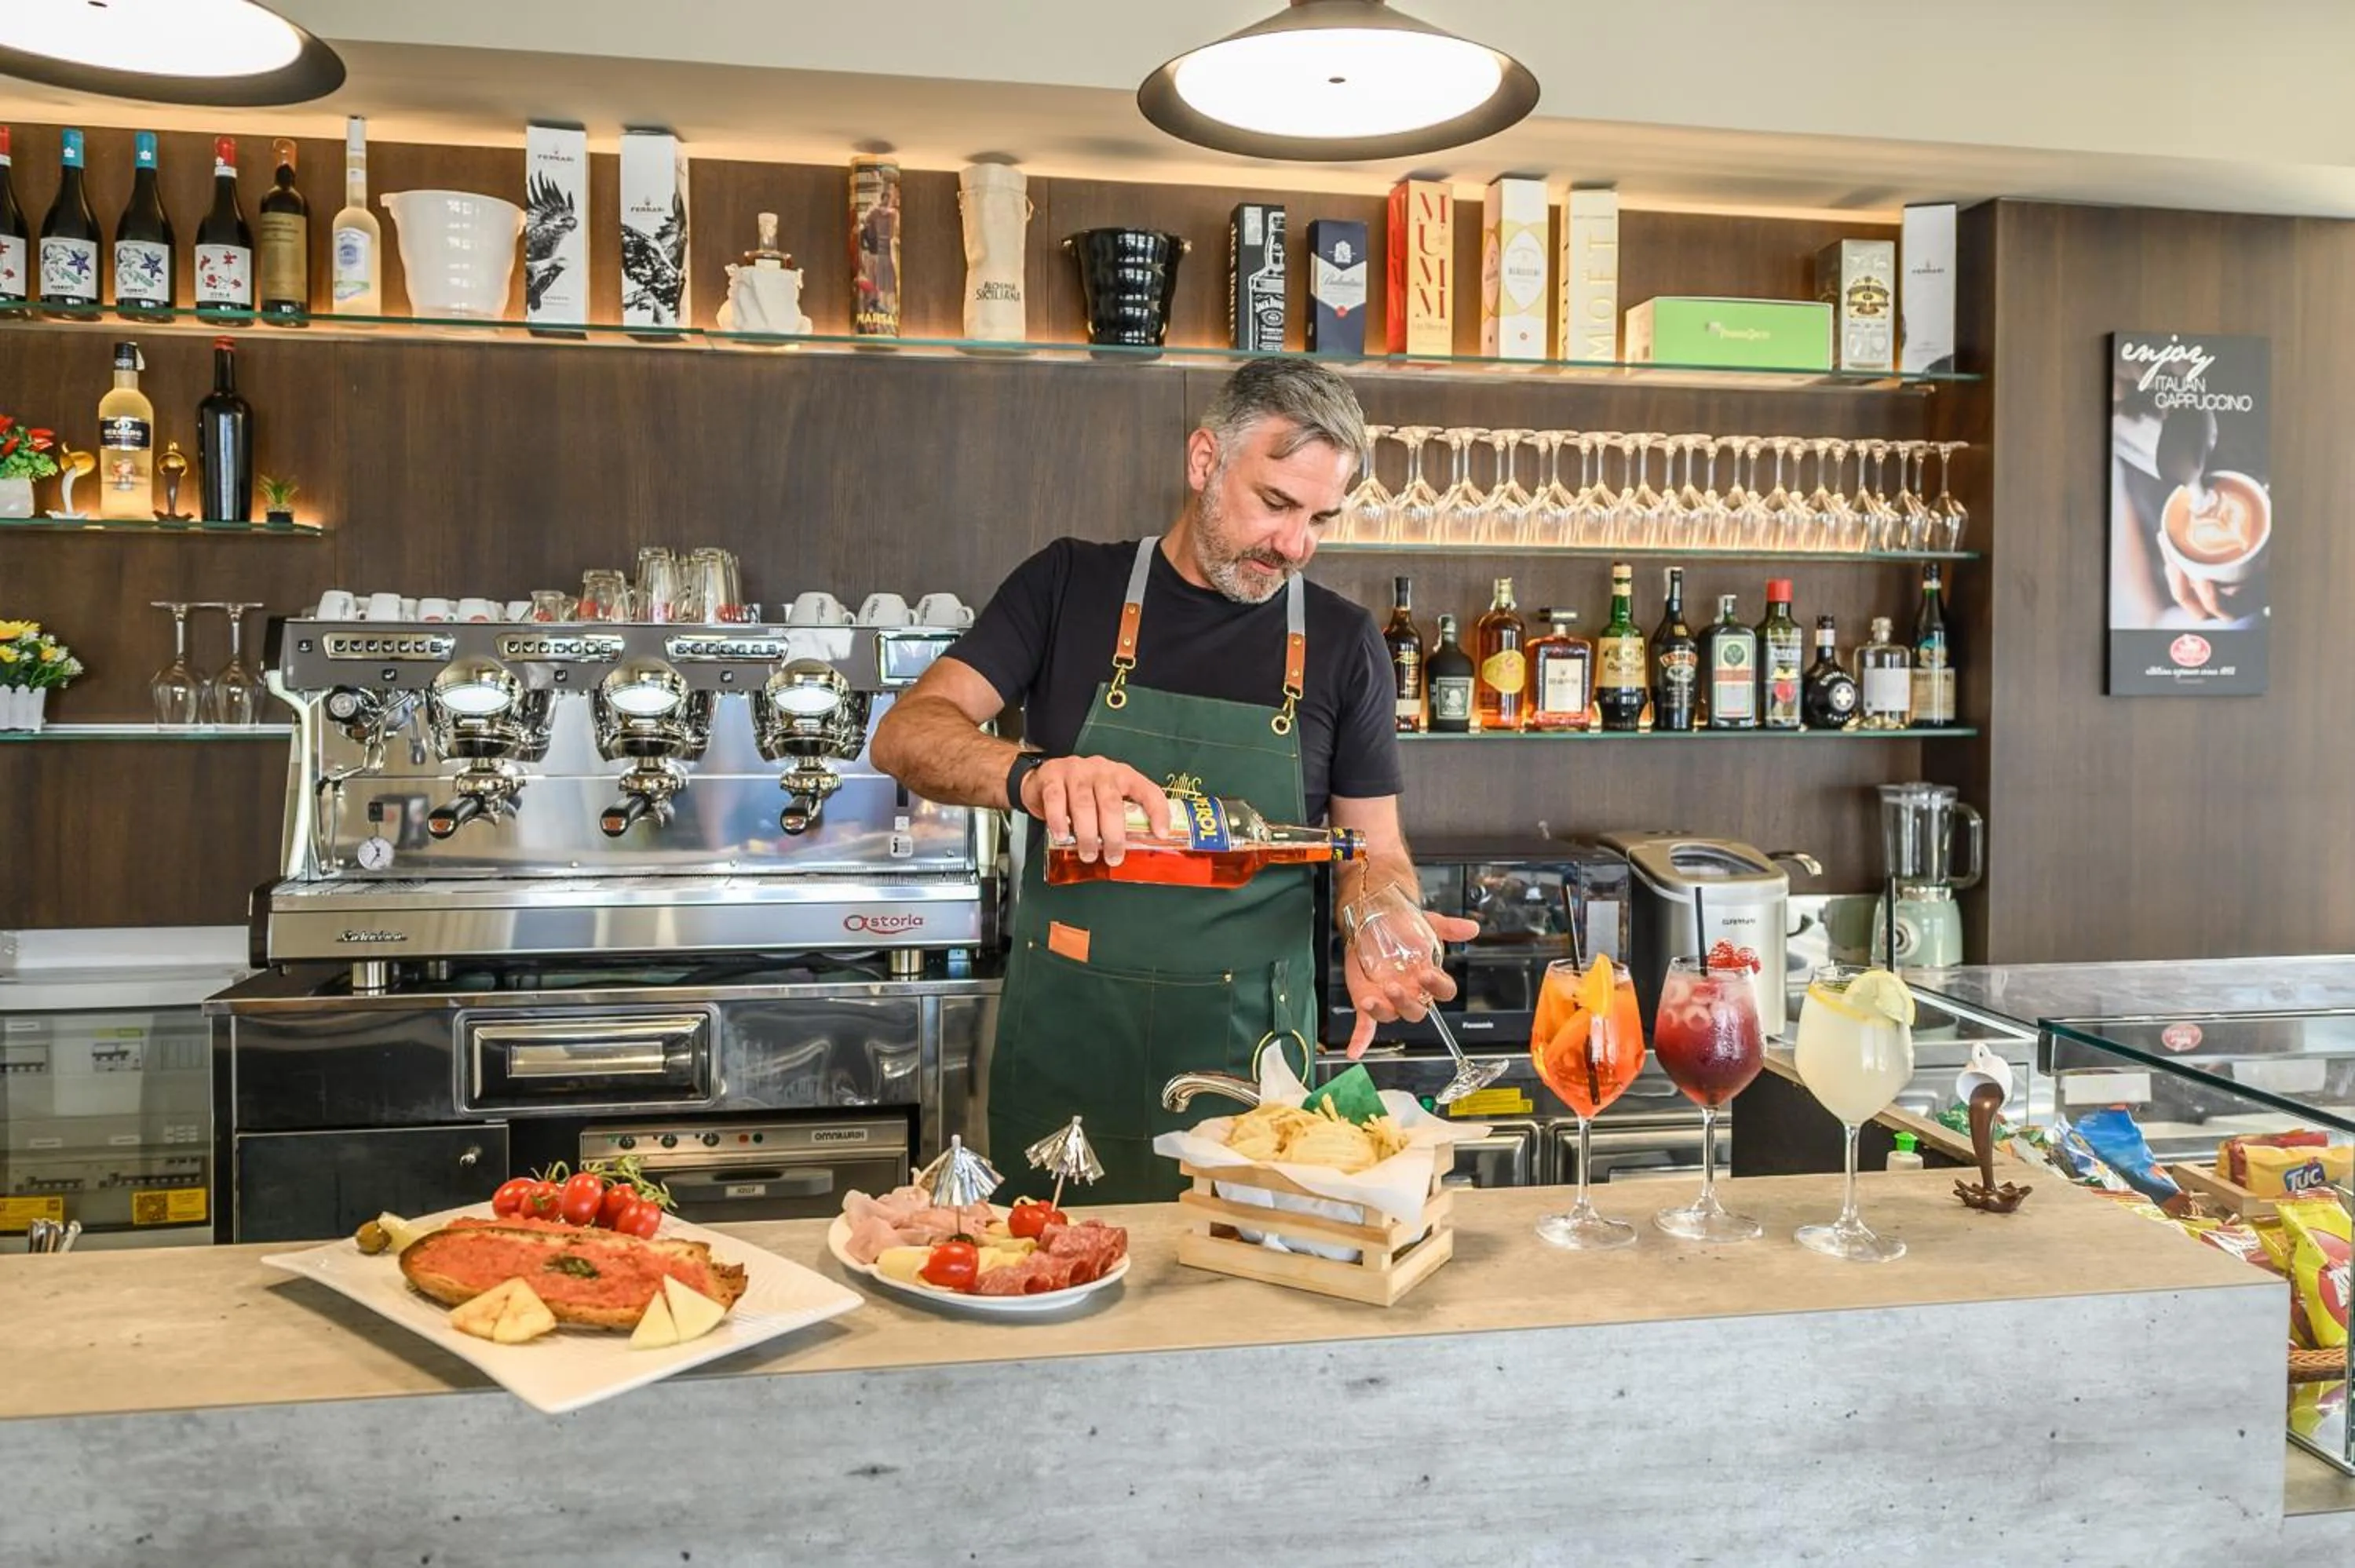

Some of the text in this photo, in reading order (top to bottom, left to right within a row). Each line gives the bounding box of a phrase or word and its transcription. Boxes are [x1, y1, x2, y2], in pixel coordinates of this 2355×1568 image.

[2121, 334, 2215, 391] enjoy
[2155, 374, 2206, 392] ITALIAN
[2154, 392, 2253, 412] CAPPUCCINO
